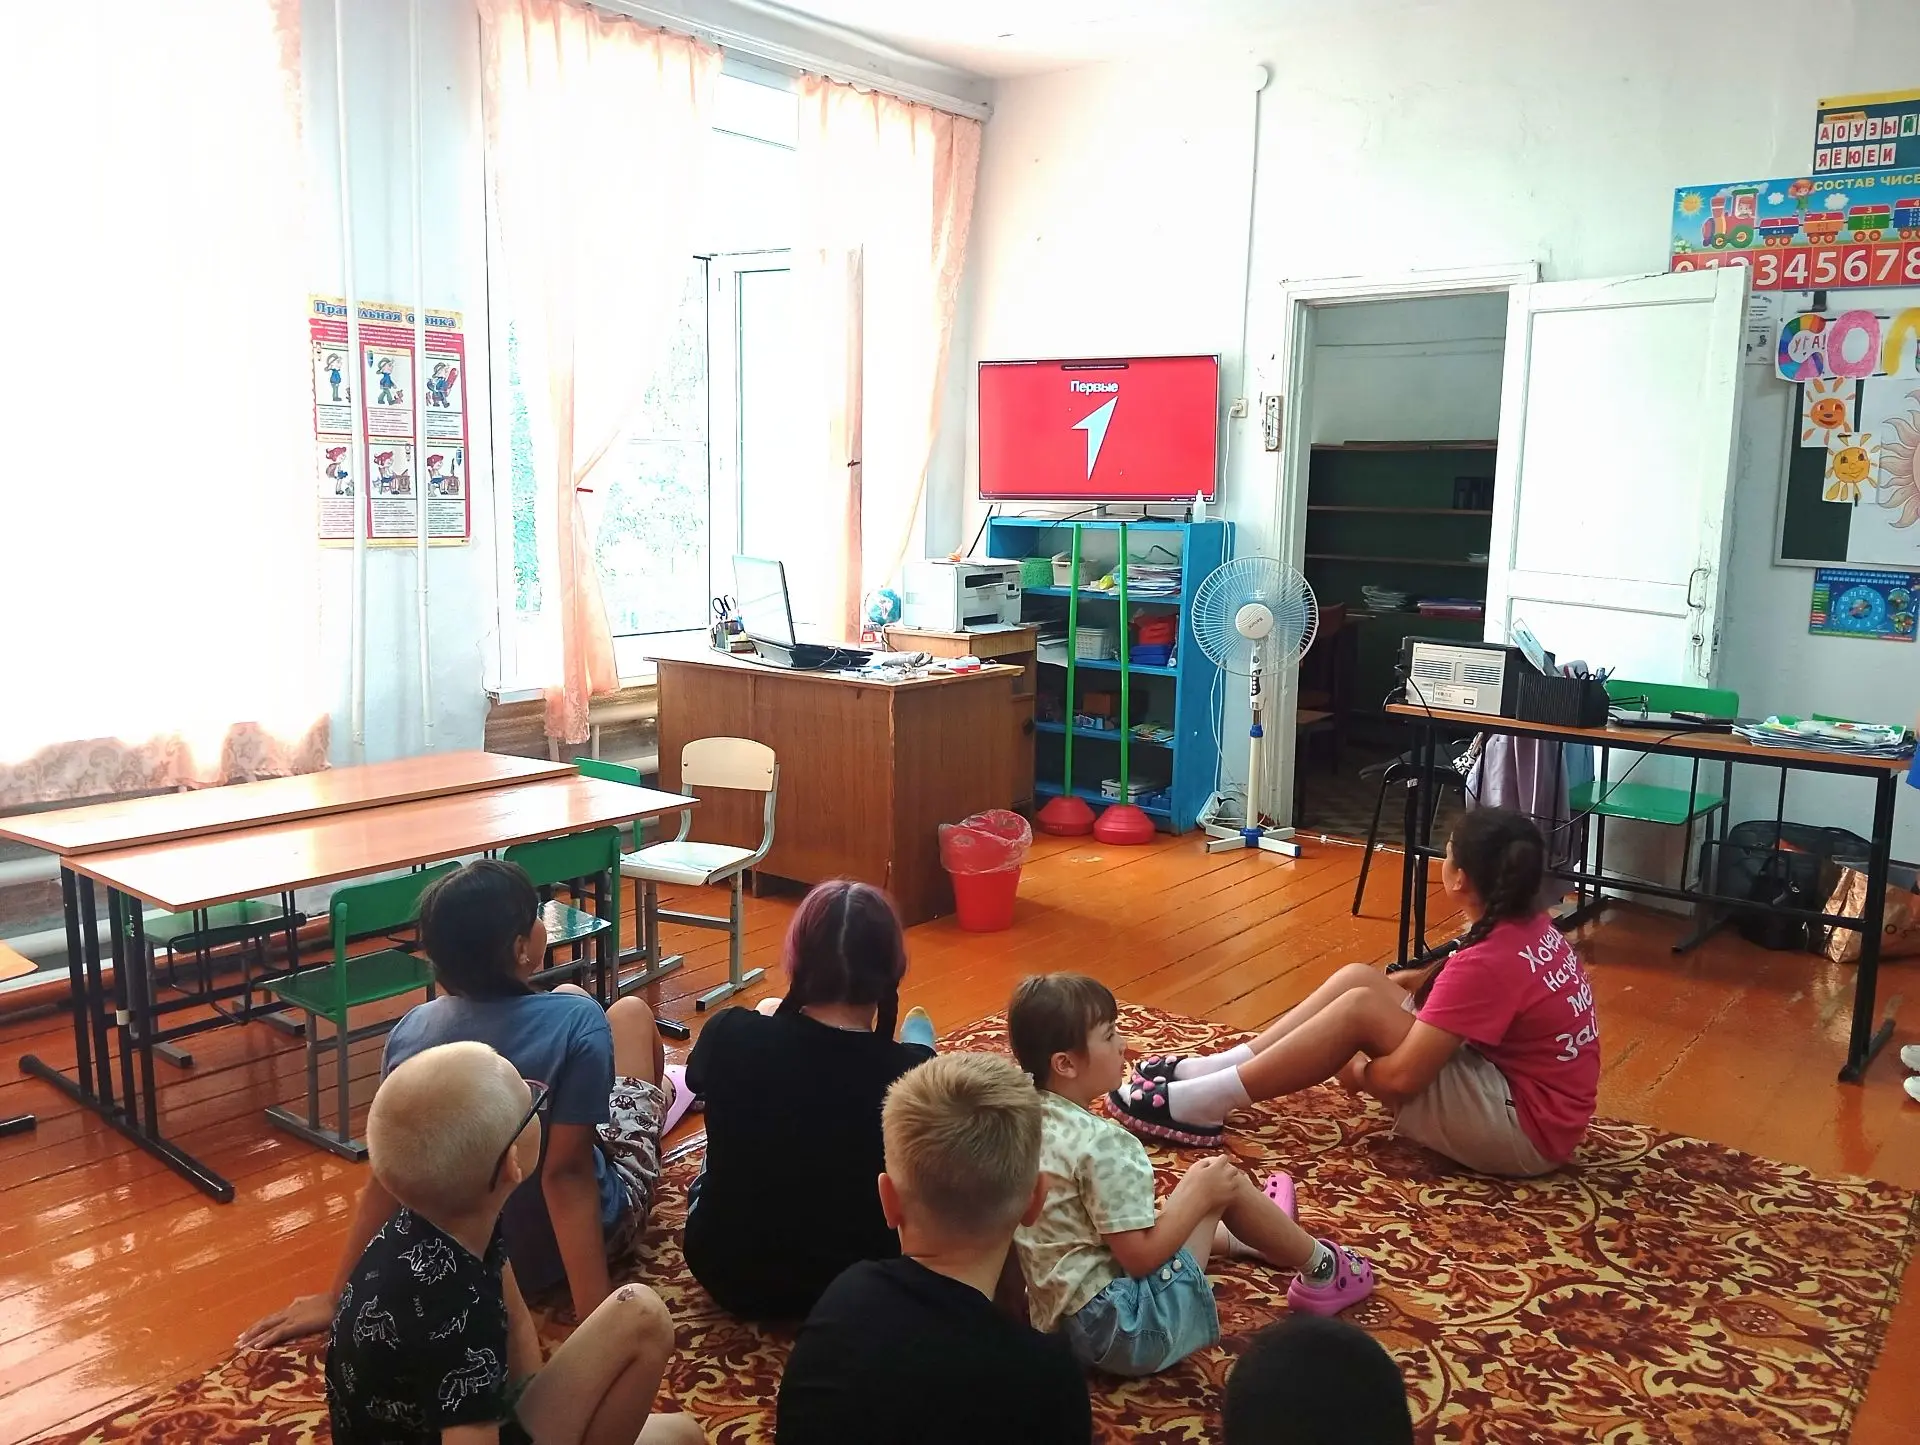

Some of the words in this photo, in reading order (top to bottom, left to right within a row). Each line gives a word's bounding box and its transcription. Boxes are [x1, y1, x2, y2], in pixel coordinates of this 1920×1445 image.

[1820, 127, 1830, 141] А
[1836, 125, 1846, 139] О
[1854, 124, 1863, 137] У
[1883, 120, 1897, 135] Ы
[1818, 153, 1828, 167] Я
[1833, 149, 1842, 166] Ё
[1848, 150, 1861, 165] Ю
[1867, 149, 1876, 163] Е
[1883, 148, 1893, 162] И
[1814, 177, 1875, 192] СОСТАВ
[1756, 254, 1778, 286] 3
[1783, 253, 1809, 285] 4
[1814, 251, 1837, 283] 5
[1843, 249, 1868, 282] 6
[1876, 249, 1899, 281] 7
[315, 301, 401, 321] Пральная
[406, 314, 455, 328] оанка
[1070, 380, 1119, 396] Первые
